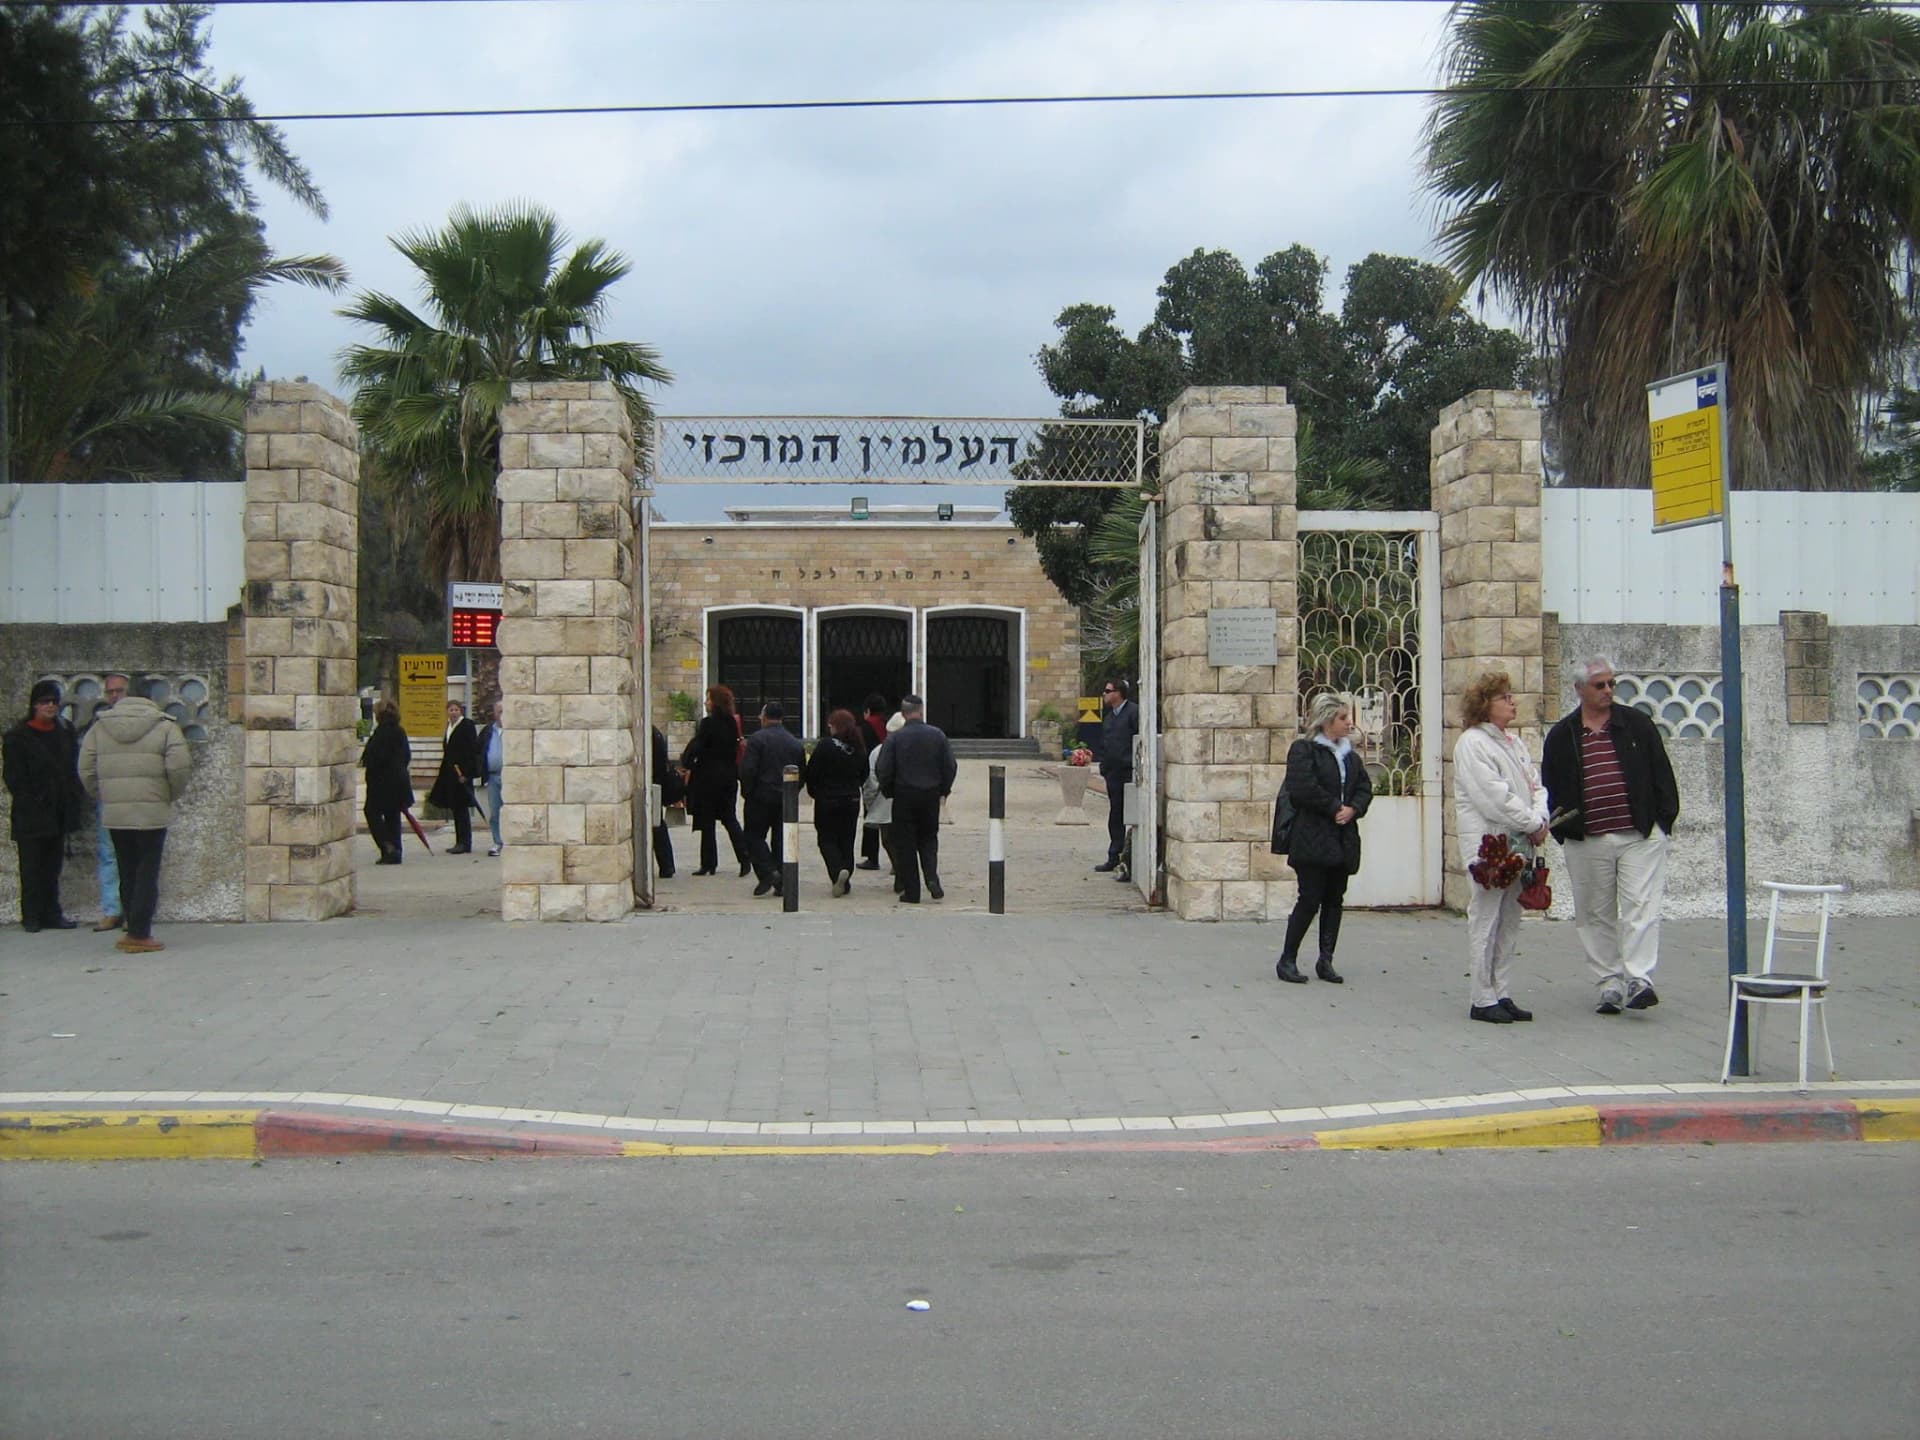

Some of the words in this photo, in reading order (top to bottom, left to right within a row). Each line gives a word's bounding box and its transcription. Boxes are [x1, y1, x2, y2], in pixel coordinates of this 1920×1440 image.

[1652, 425, 1663, 439] 127
[683, 433, 840, 463] המרכזי
[859, 425, 1018, 473] העלמין
[1652, 441, 1664, 457] 127
[759, 569, 781, 580] חי
[798, 567, 837, 580] לכל
[856, 569, 914, 581] מועד
[932, 569, 971, 580] בית
[404, 661, 444, 671] מודיעין
